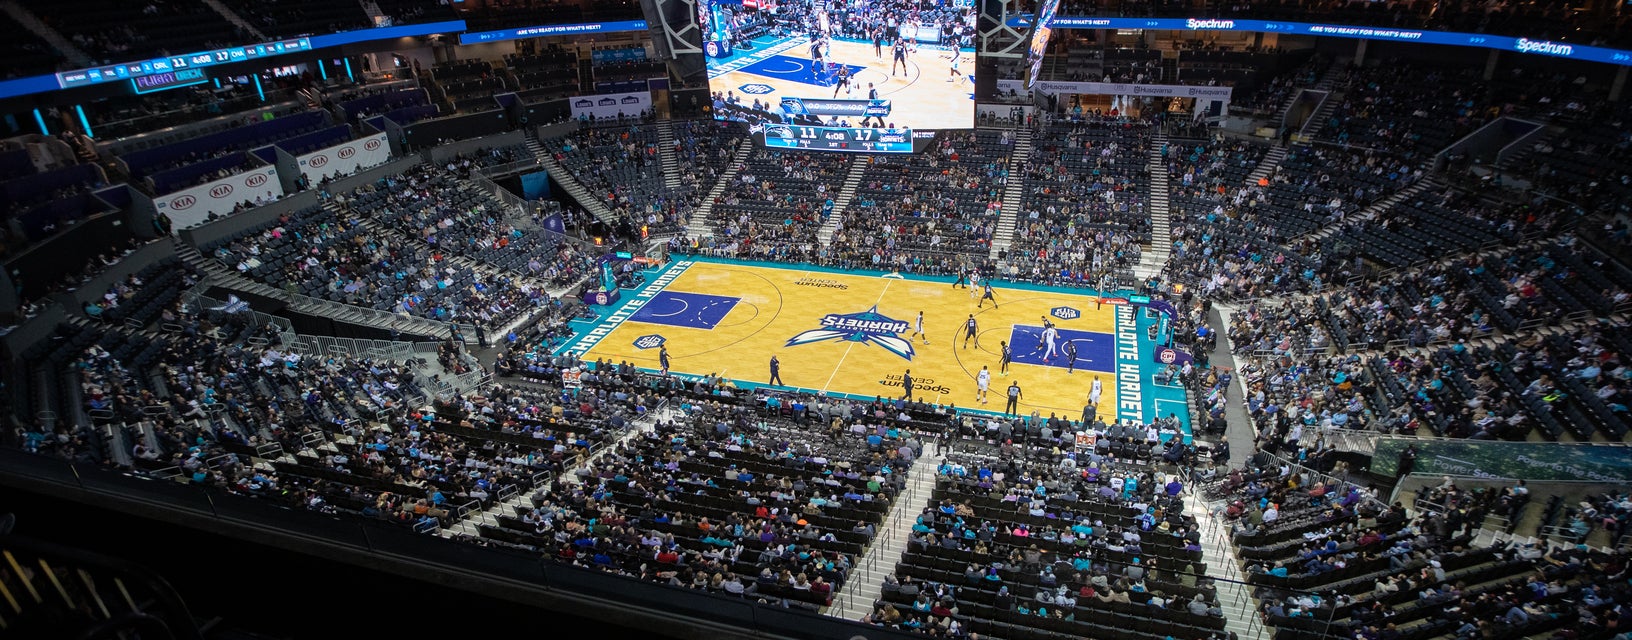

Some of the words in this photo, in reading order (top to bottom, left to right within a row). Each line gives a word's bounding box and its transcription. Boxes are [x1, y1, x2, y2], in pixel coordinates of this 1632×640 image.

[1187, 18, 1234, 30] Spectrum
[1373, 30, 1399, 38] WHAT'S
[1517, 38, 1572, 55] Spectrum
[172, 58, 187, 68] 11
[192, 55, 212, 65] 4:08
[216, 51, 229, 61] 17
[1047, 83, 1077, 91] Husqvarna
[1141, 86, 1173, 95] Husqvarna
[1196, 88, 1228, 97] Husqvarna
[800, 127, 817, 139] 11
[825, 132, 845, 140] 4:08
[855, 129, 872, 141] 17
[366, 140, 379, 150] KIA
[340, 148, 353, 158] KIA
[311, 156, 326, 167] KIA
[248, 175, 265, 186] KIA
[212, 185, 231, 197] KIA
[174, 197, 193, 209] KIA
[795, 281, 849, 291] Spectrum
[563, 298, 645, 358] CHARLOTTE
[637, 259, 693, 298] HORNETS
[823, 315, 907, 333] HORNETS
[836, 325, 887, 334] CHARLOTTE
[1117, 303, 1139, 362] HARLOTTE
[886, 373, 935, 385] CENER
[882, 380, 951, 395] Spectum
[1517, 455, 1551, 468] Power
